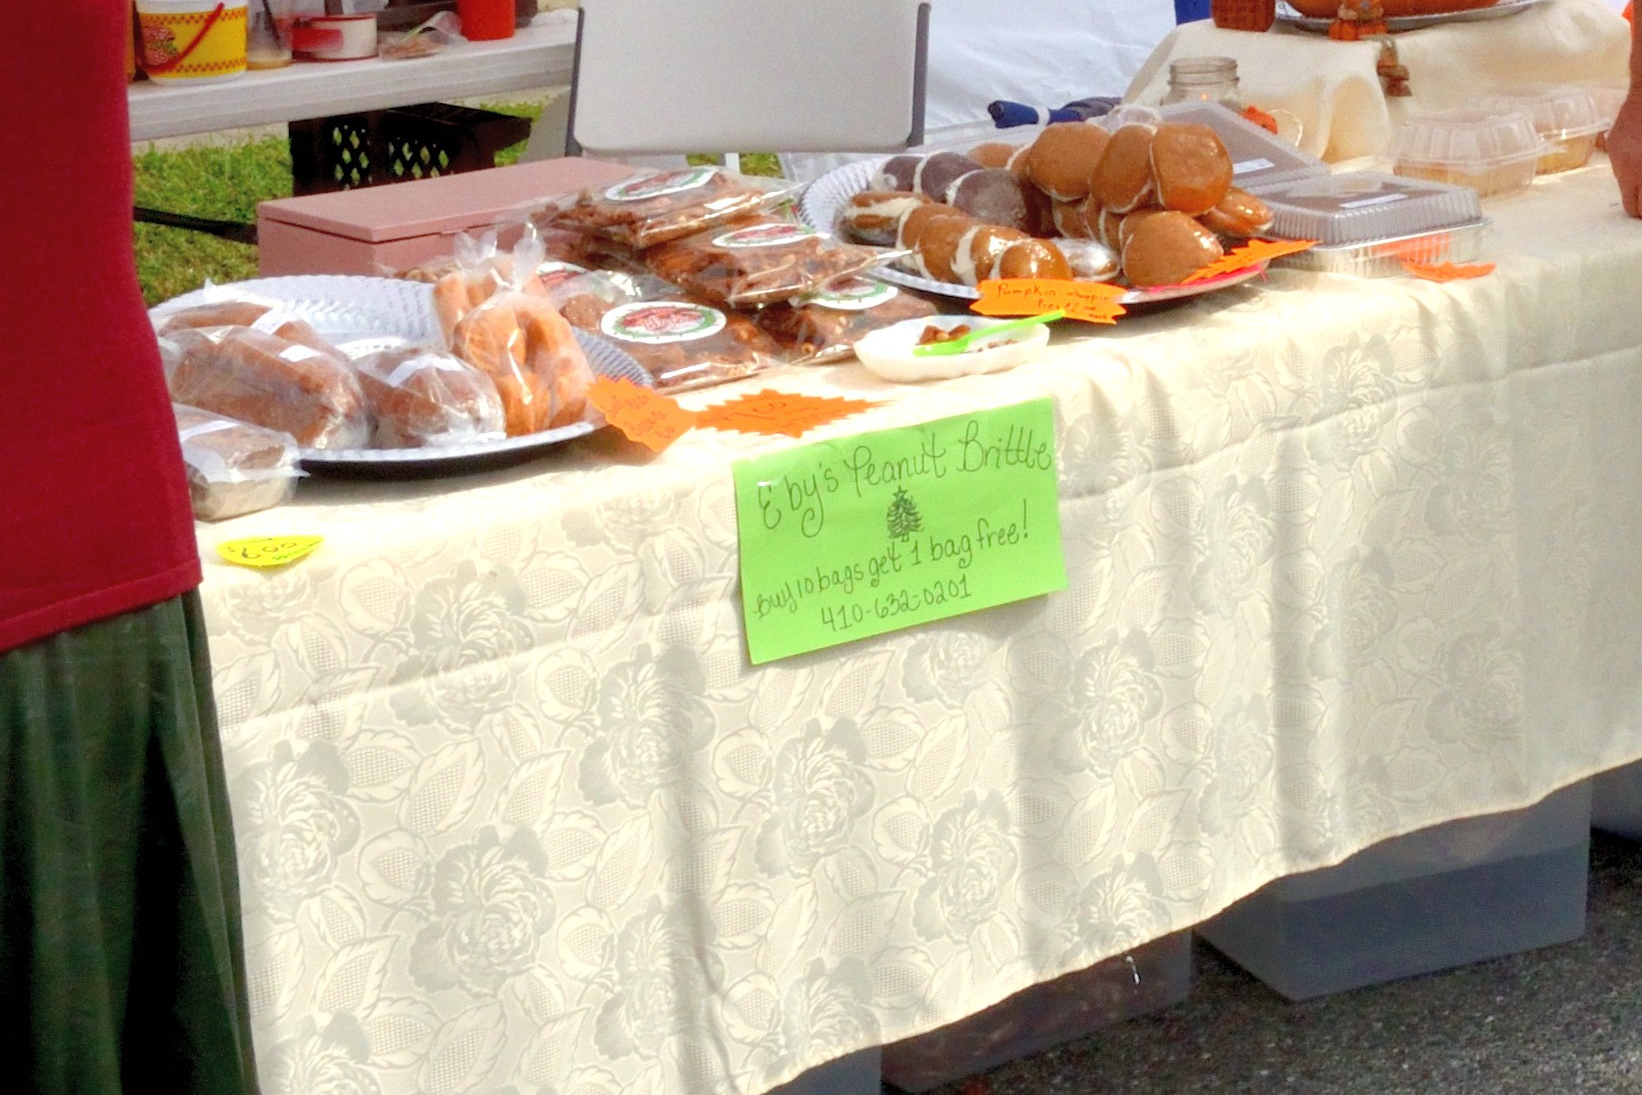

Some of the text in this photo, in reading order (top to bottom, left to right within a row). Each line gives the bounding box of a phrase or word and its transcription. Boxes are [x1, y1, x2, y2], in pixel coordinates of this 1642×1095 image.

[997, 282, 1057, 298] Pumpkin
[758, 419, 1052, 538] Eby's Peanut Brittle
[816, 563, 864, 595] bags
[868, 542, 902, 587] get
[910, 540, 922, 566] 1
[930, 535, 973, 569] bag
[977, 498, 1029, 549] free!
[820, 573, 973, 632] 410-632-0201
